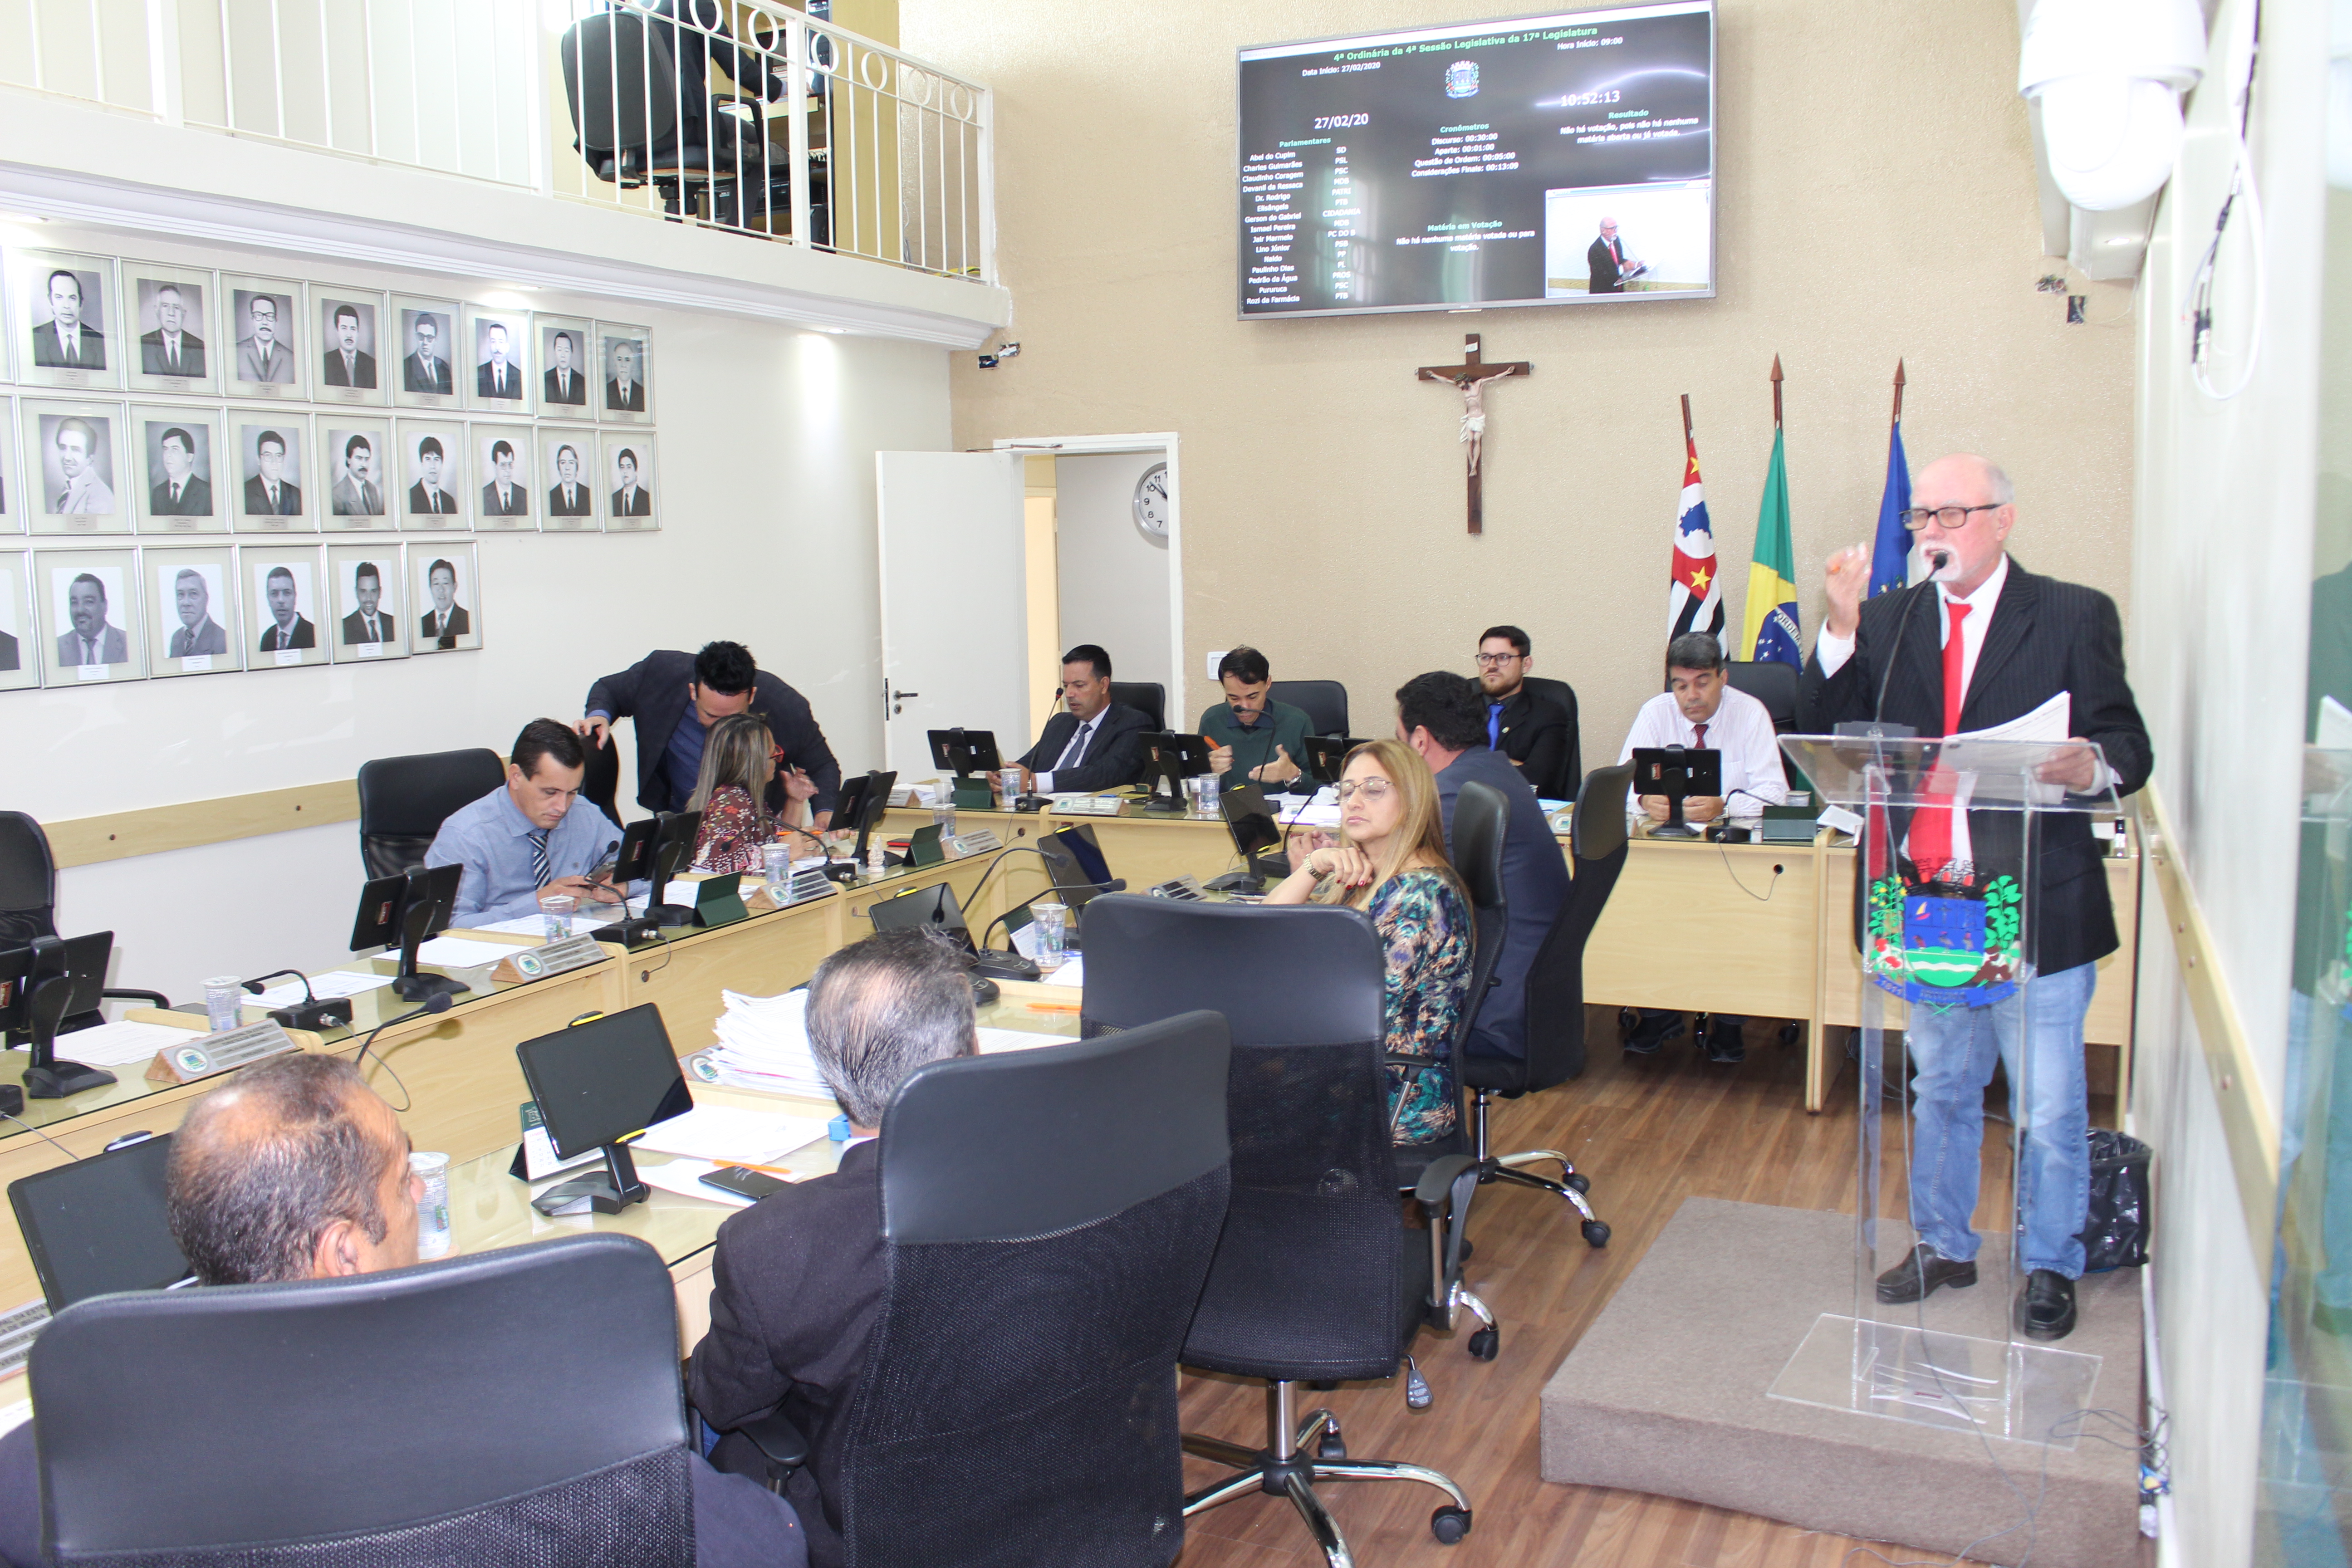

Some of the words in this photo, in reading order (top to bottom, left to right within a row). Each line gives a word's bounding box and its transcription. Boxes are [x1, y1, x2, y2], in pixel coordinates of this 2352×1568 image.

[1347, 49, 1389, 60] Ordinária
[1392, 47, 1403, 55] da
[1419, 42, 1452, 53] Sessão
[1454, 37, 1505, 50] Legislativa
[1508, 34, 1519, 43] da
[1543, 27, 1597, 40] Legislatura
[1557, 42, 1574, 50] Hora
[1576, 39, 1598, 48] Início:
[1601, 37, 1623, 46] 09:00
[1302, 69, 1318, 77] Data
[1319, 67, 1339, 75] Início:
[1342, 62, 1381, 73] 27/02/2020
[1561, 90, 1620, 106] 10:52:13
[1608, 109, 1649, 119] Resultado
[1314, 113, 1368, 130] 27/02/20
[1576, 125, 1585, 133] há
[1588, 123, 1618, 132] votação,
[1619, 122, 1635, 132] pois
[1637, 120, 1651, 129] não
[1652, 118, 1662, 127] há
[1664, 117, 1699, 127] nenhuma
[1440, 123, 1490, 133] Cronômetros
[1279, 137, 1331, 147] Parlamentares
[1431, 136, 1464, 146] Discurso:
[1465, 132, 1498, 142] 00:30:00
[1577, 135, 1605, 144] matéria
[1607, 132, 1631, 142] aberta
[1643, 131, 1651, 140] já
[1434, 146, 1460, 156] Aparte:
[1461, 143, 1494, 153] 00:01:00
[1250, 153, 1264, 162] Abel
[1275, 151, 1295, 159] Cupim
[1414, 157, 1443, 168] Questão
[1455, 155, 1480, 163] Ordem:
[1482, 152, 1515, 161] 00:05:00
[1268, 161, 1303, 170] Guimarães
[1411, 167, 1460, 177] Considerações
[1461, 165, 1484, 173] Finais:
[1485, 162, 1519, 172] 00:13:09
[1242, 173, 1274, 182] Claudinho
[1275, 172, 1303, 180] Coragem
[1243, 184, 1266, 192] Devanil
[1332, 187, 1351, 196] PATRI
[1266, 193, 1290, 202] Rodrigo
[1257, 203, 1289, 212] Elisângela
[1323, 208, 1360, 217] CIDADANIA
[1278, 212, 1301, 220] Gabriel
[1274, 223, 1296, 231] Pereira
[1428, 223, 1456, 232] Matéria
[1471, 220, 1502, 230] Votação
[1266, 234, 1293, 242] Marmelo
[1421, 235, 1453, 243] nenhuma
[1483, 231, 1506, 240] votada
[1519, 230, 1535, 239] para
[1271, 244, 1290, 252] Júnior
[1281, 274, 1298, 283] Água
[1271, 295, 1300, 303] Farmácia
